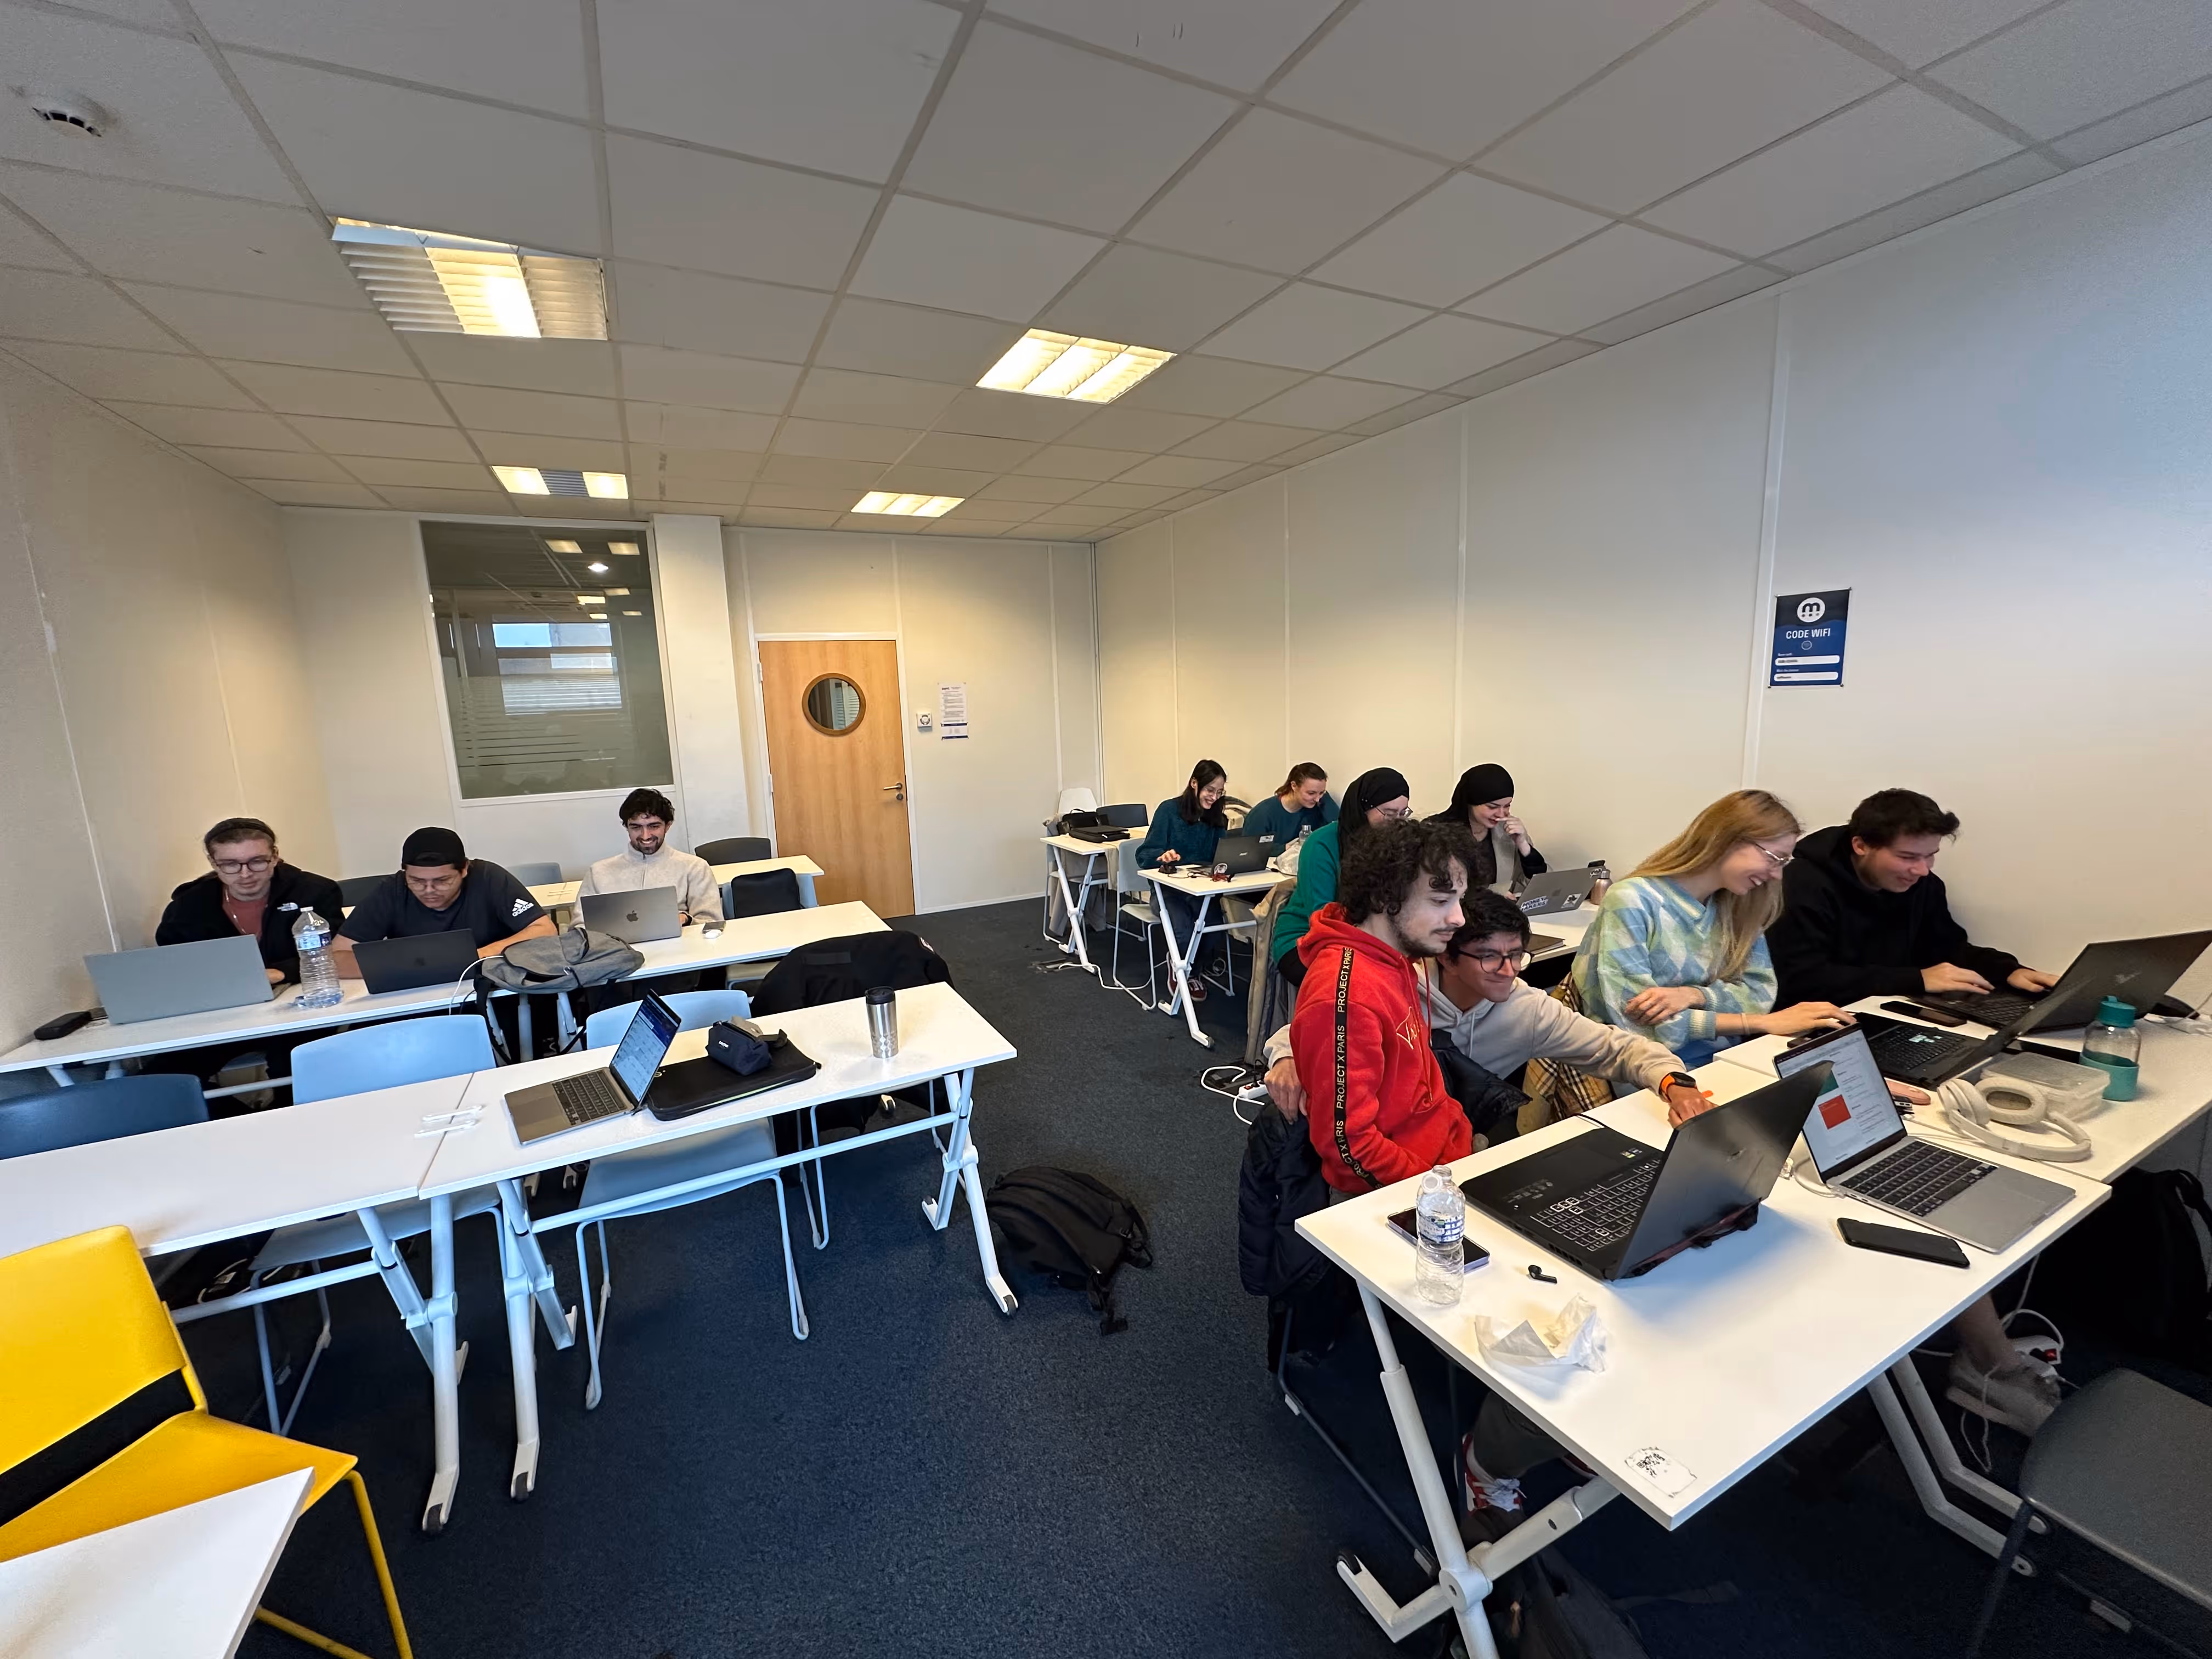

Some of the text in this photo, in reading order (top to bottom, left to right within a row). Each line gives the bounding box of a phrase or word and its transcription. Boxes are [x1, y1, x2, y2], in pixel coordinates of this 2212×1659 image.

[1786, 628, 1831, 639] CODE WIFI
[512, 902, 534, 917] adidas
[1343, 947, 1352, 964] PARIS
[1338, 970, 1349, 1013] PROJECT
[1337, 1025, 1345, 1053] PARIS
[1336, 1063, 1345, 1109] PROJECT
